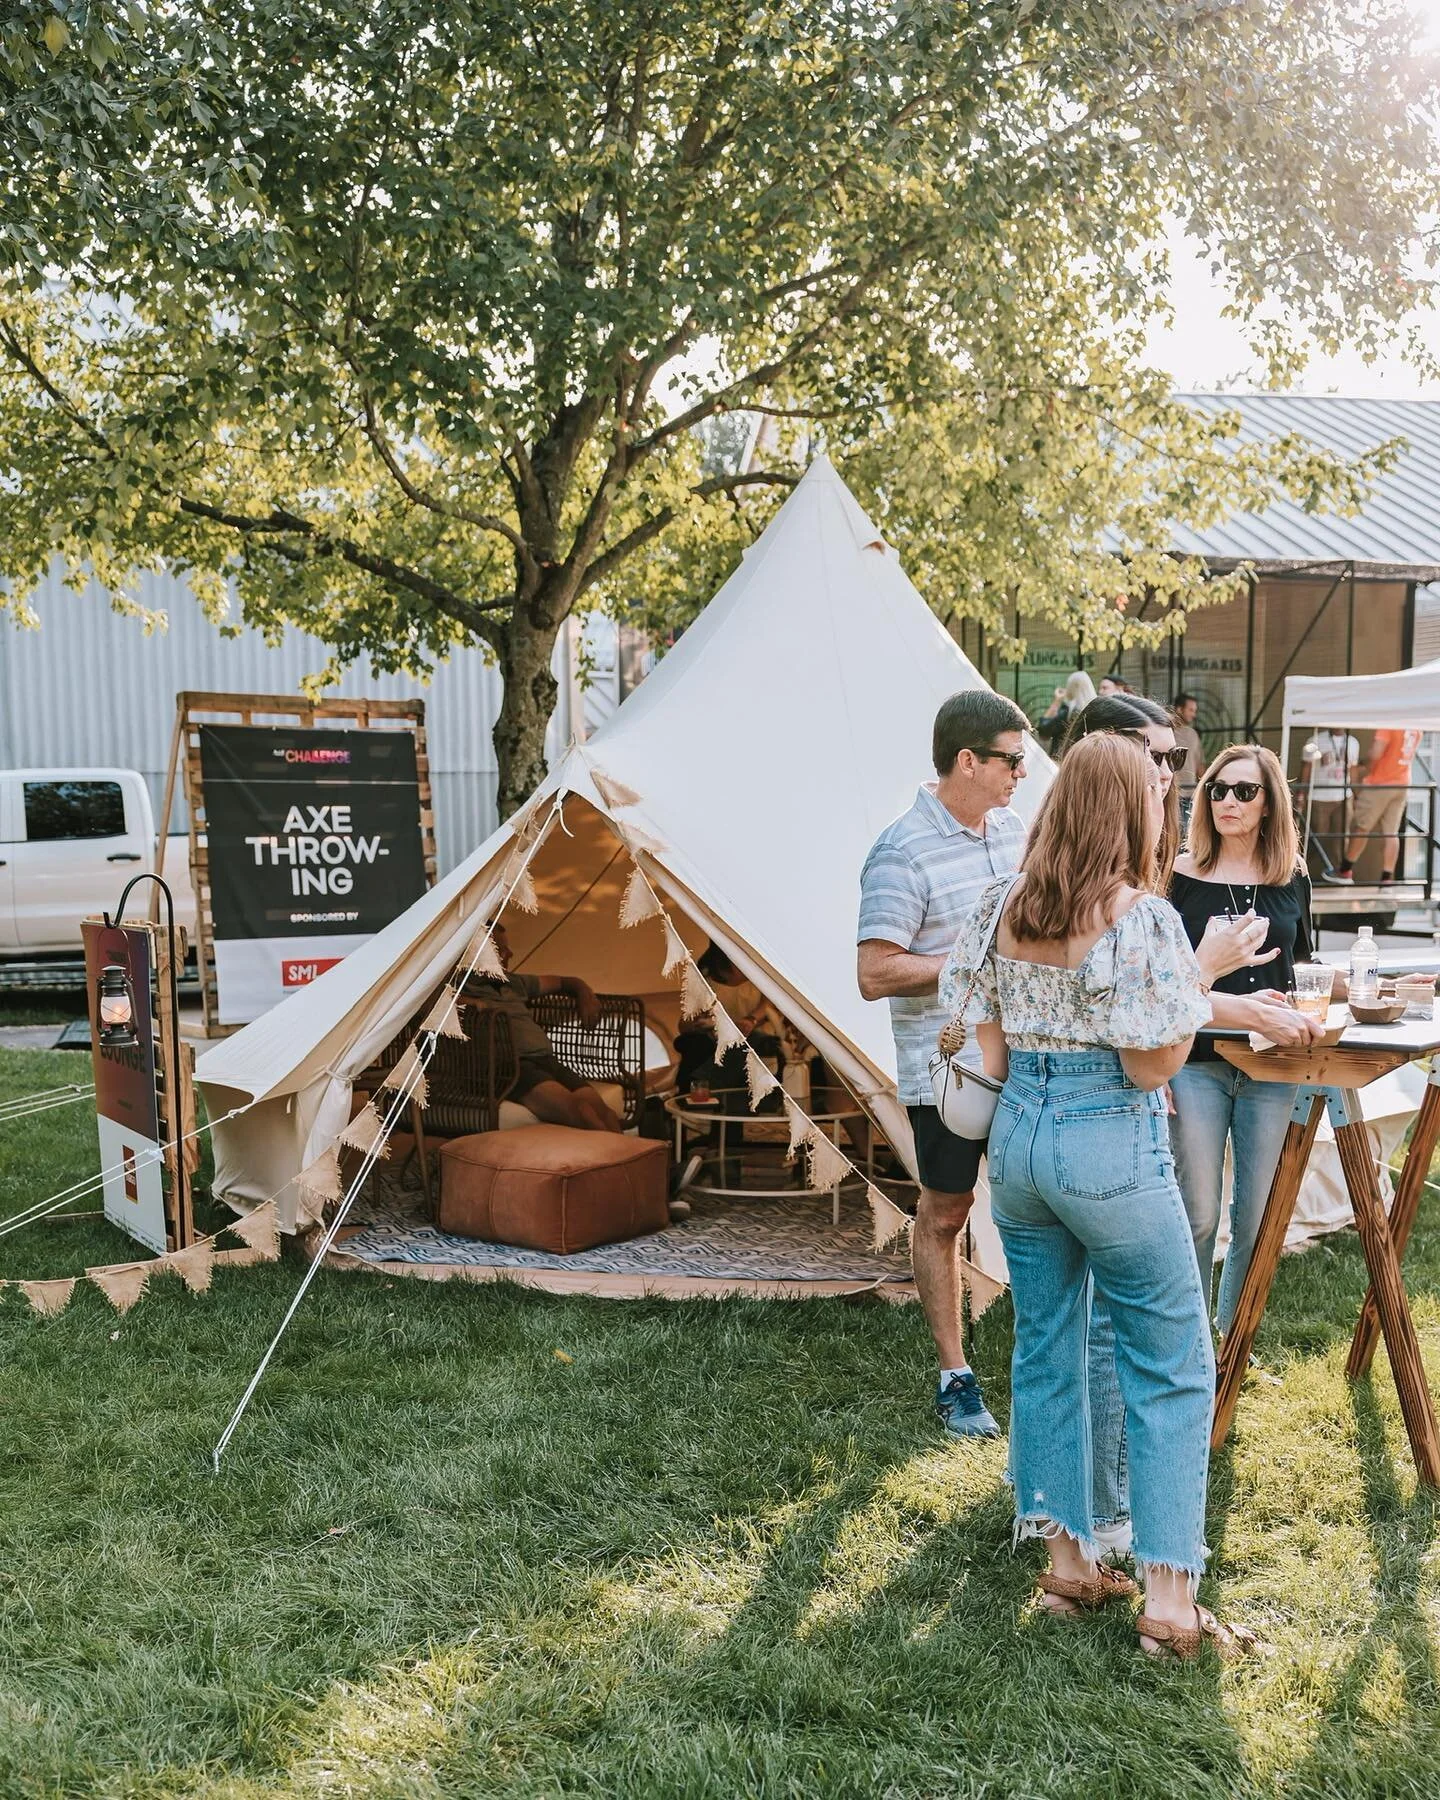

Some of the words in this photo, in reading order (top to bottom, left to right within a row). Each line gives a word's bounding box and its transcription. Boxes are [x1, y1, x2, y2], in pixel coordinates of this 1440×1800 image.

[283, 805, 353, 833] AXE
[245, 835, 390, 866] THROW-
[291, 867, 354, 896] ING
[290, 912, 346, 923] SPONSORED
[346, 911, 359, 921] BY
